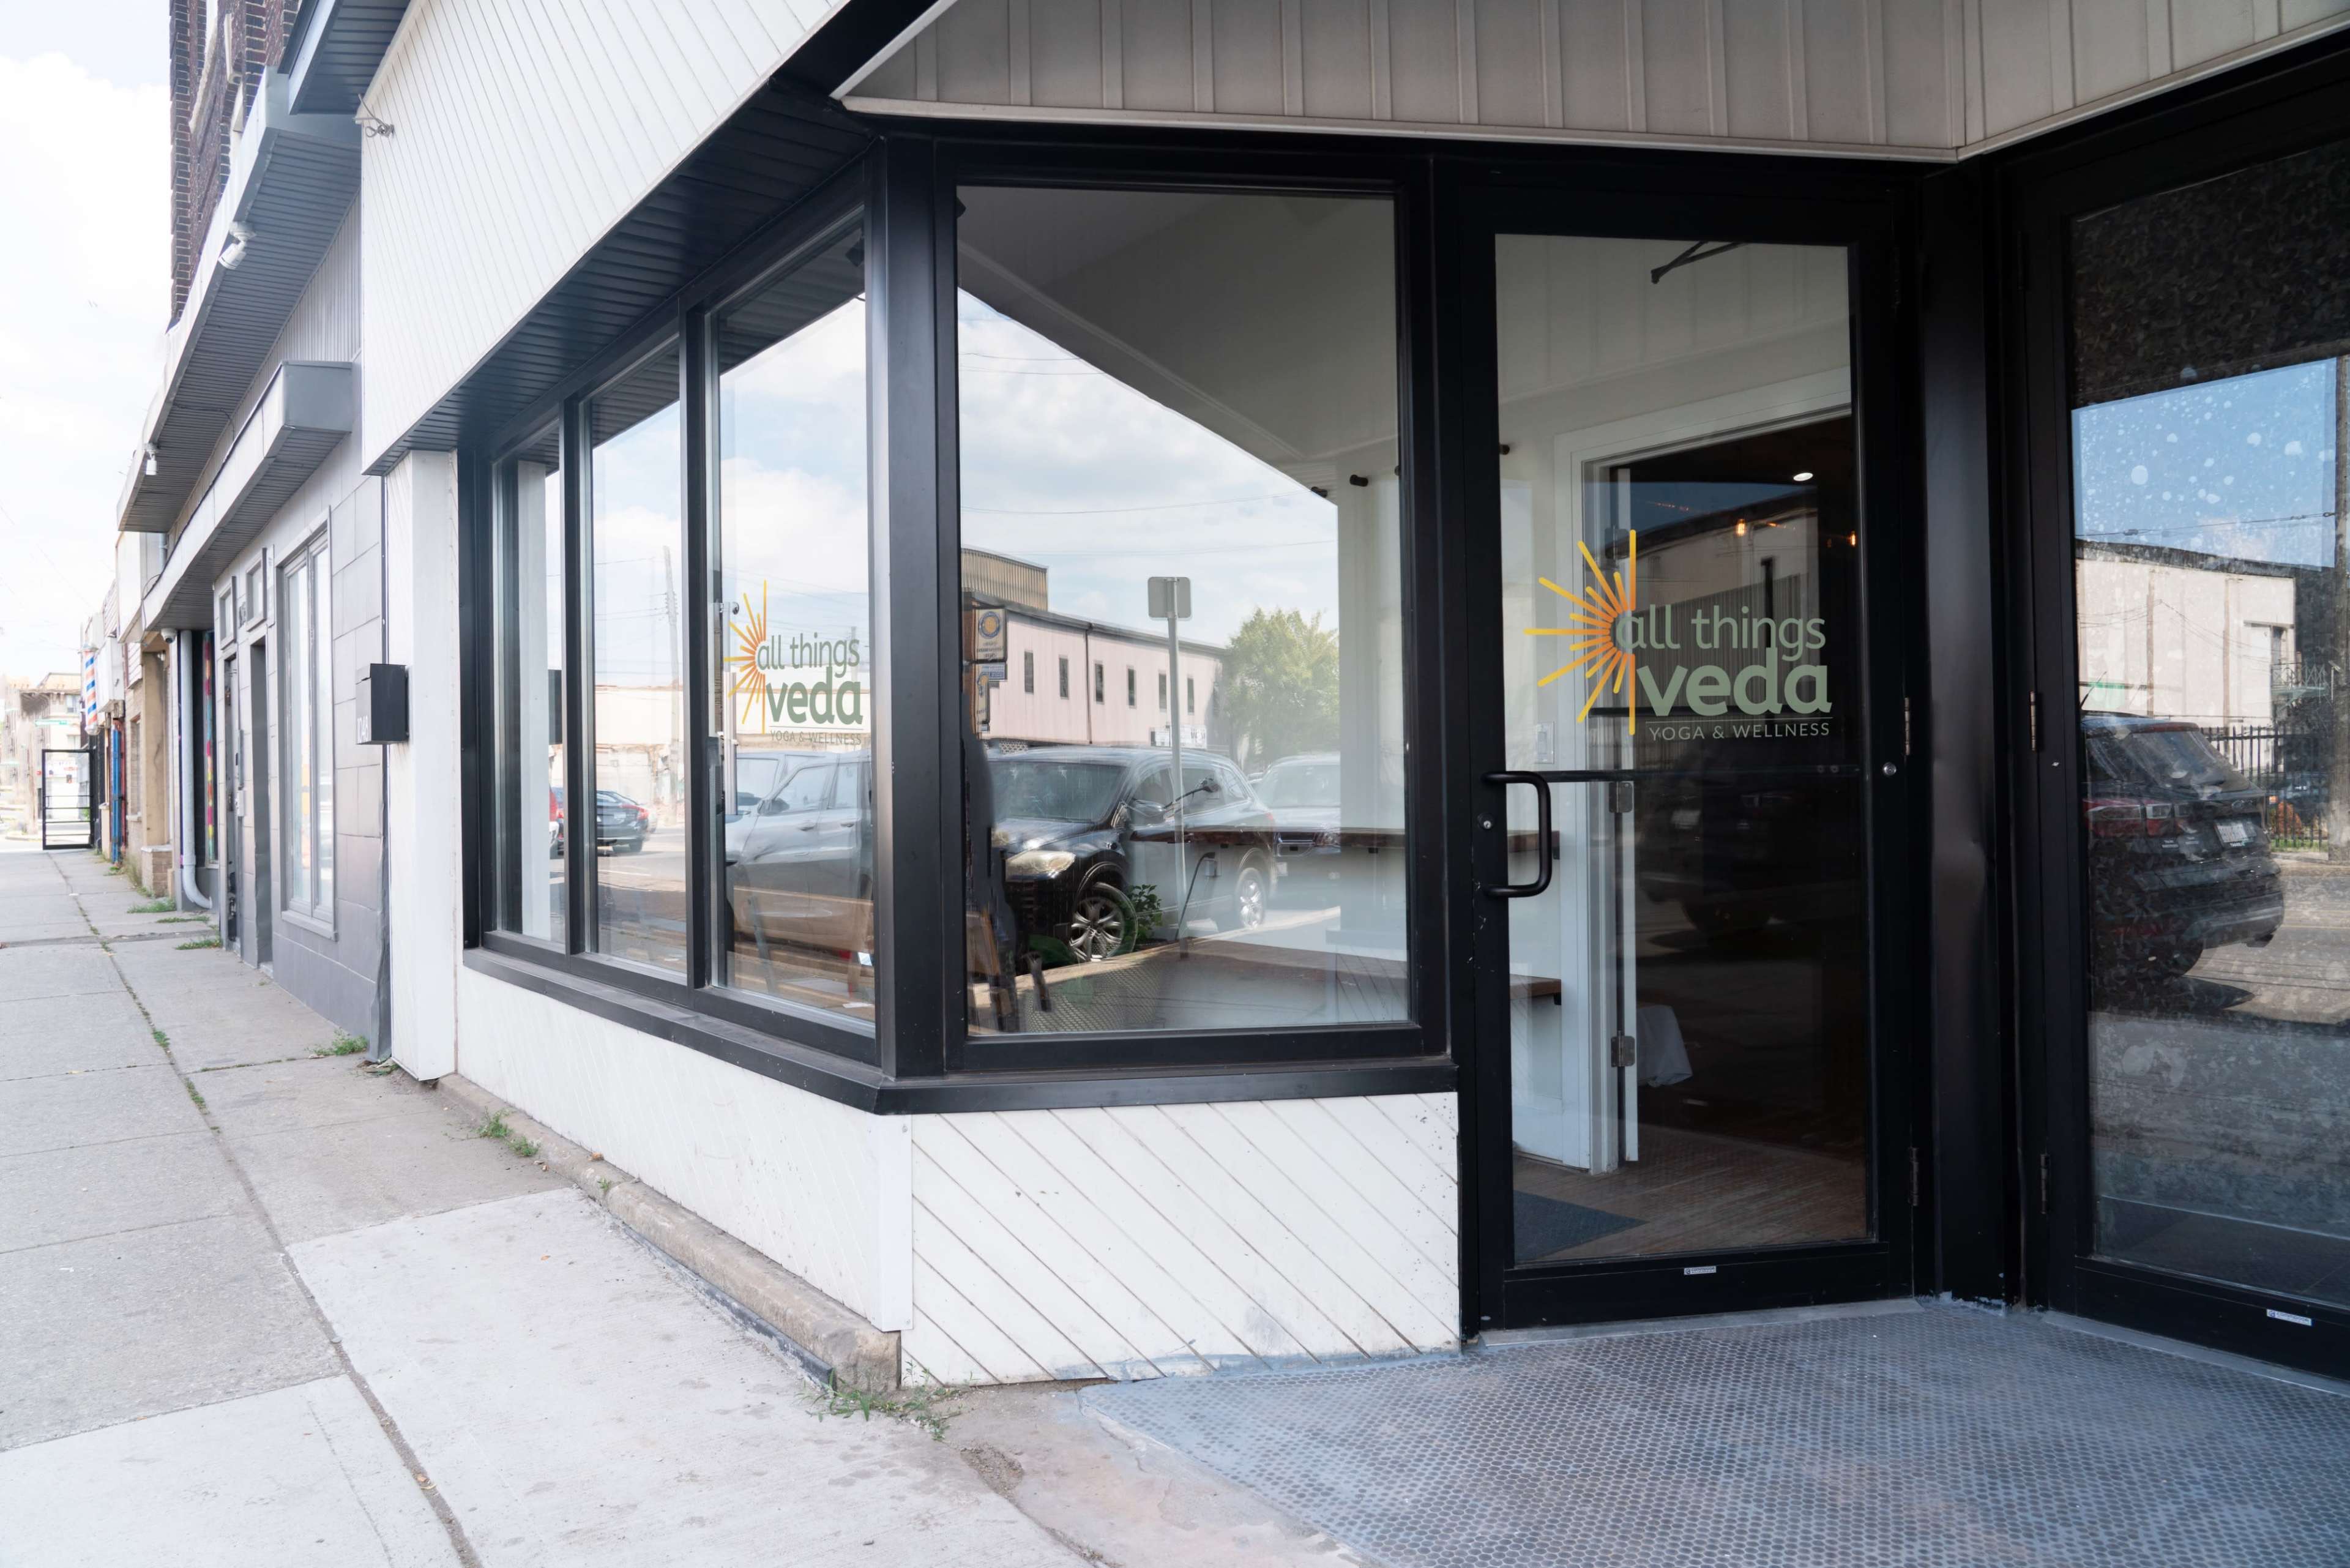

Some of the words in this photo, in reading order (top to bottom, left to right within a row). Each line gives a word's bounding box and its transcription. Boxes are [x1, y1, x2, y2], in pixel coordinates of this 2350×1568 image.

[758, 635, 785, 670] all
[789, 632, 860, 678] things
[1616, 605, 1680, 649] all
[1691, 605, 1826, 661] things
[766, 666, 864, 725] veda
[1636, 647, 1832, 717] veda
[770, 730, 796, 742] YOGA
[808, 731, 862, 745] WELLNESS
[1649, 726, 1705, 741] YOGA
[1712, 726, 1725, 739] &
[1733, 722, 1830, 738] WELLNESS
